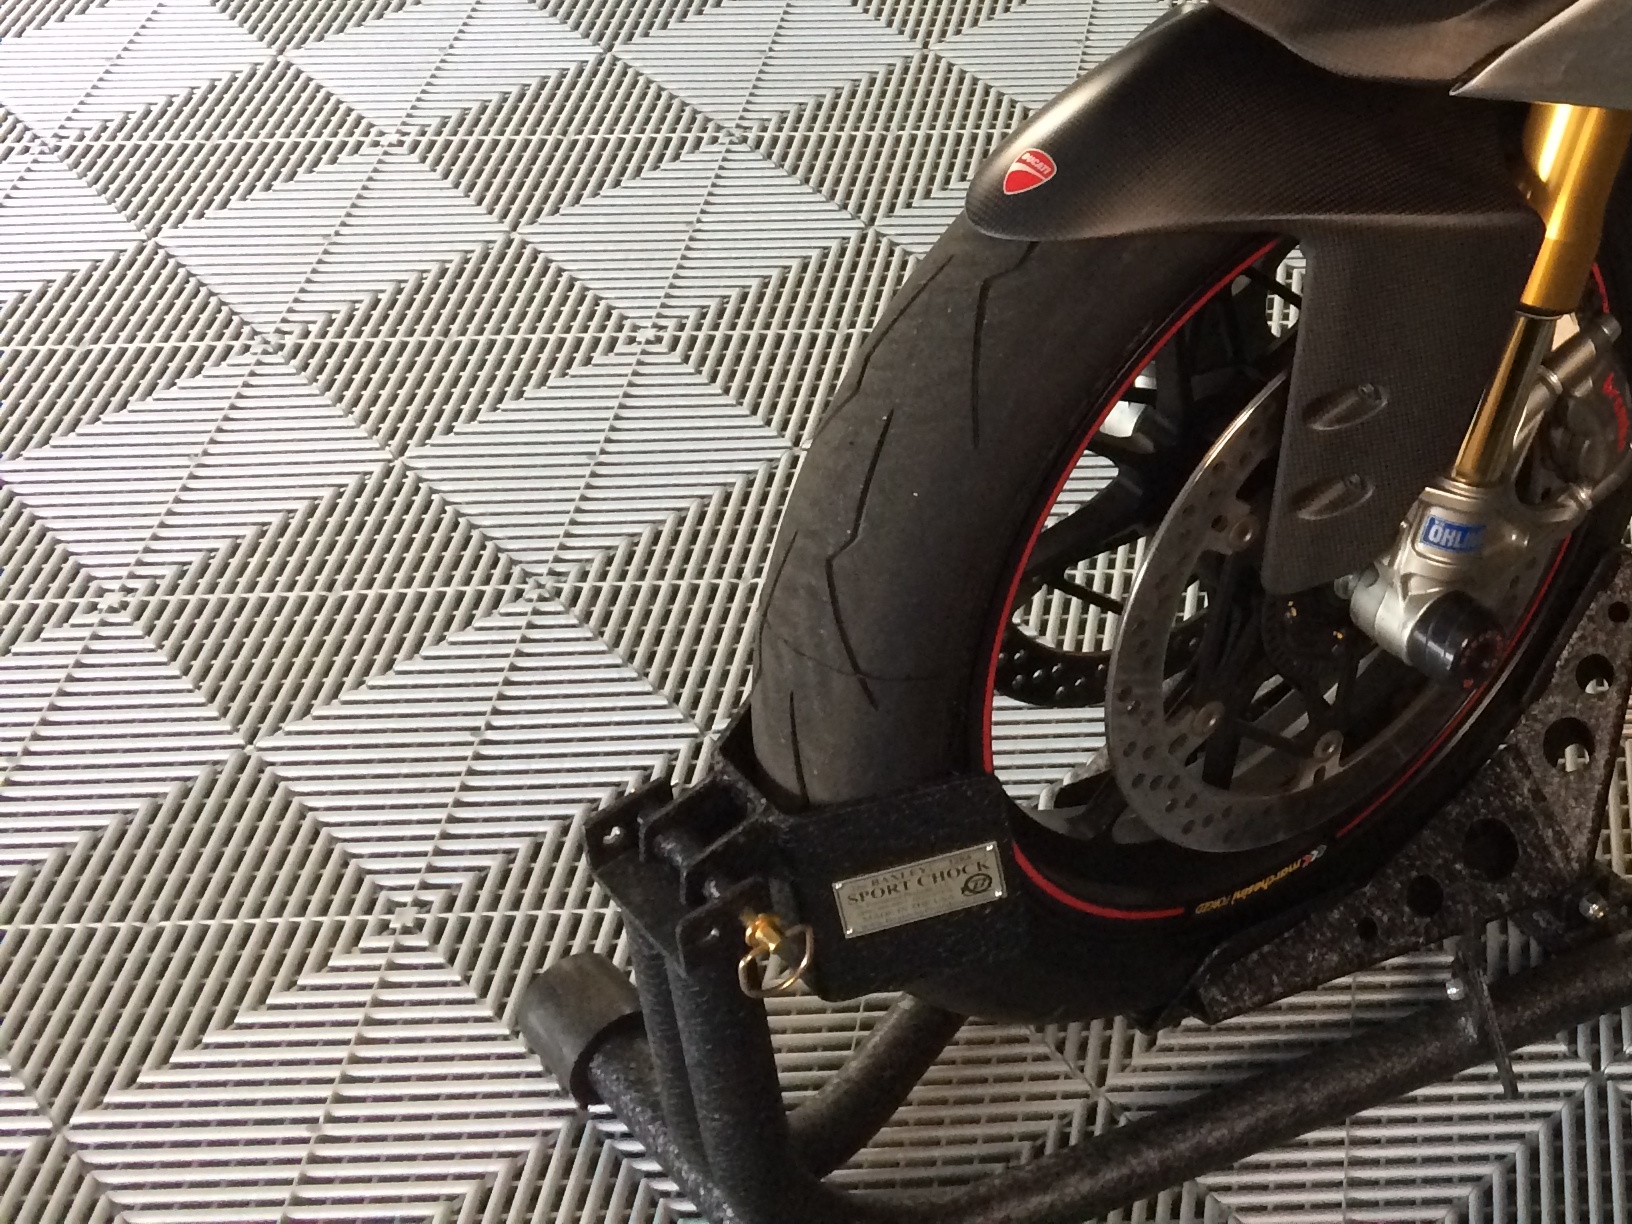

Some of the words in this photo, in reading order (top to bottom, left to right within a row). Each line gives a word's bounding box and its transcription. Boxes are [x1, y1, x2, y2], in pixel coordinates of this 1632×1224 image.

[1021, 152, 1052, 175] DUCATI
[847, 879, 913, 903] SPORT
[917, 861, 990, 888] CHOCK
